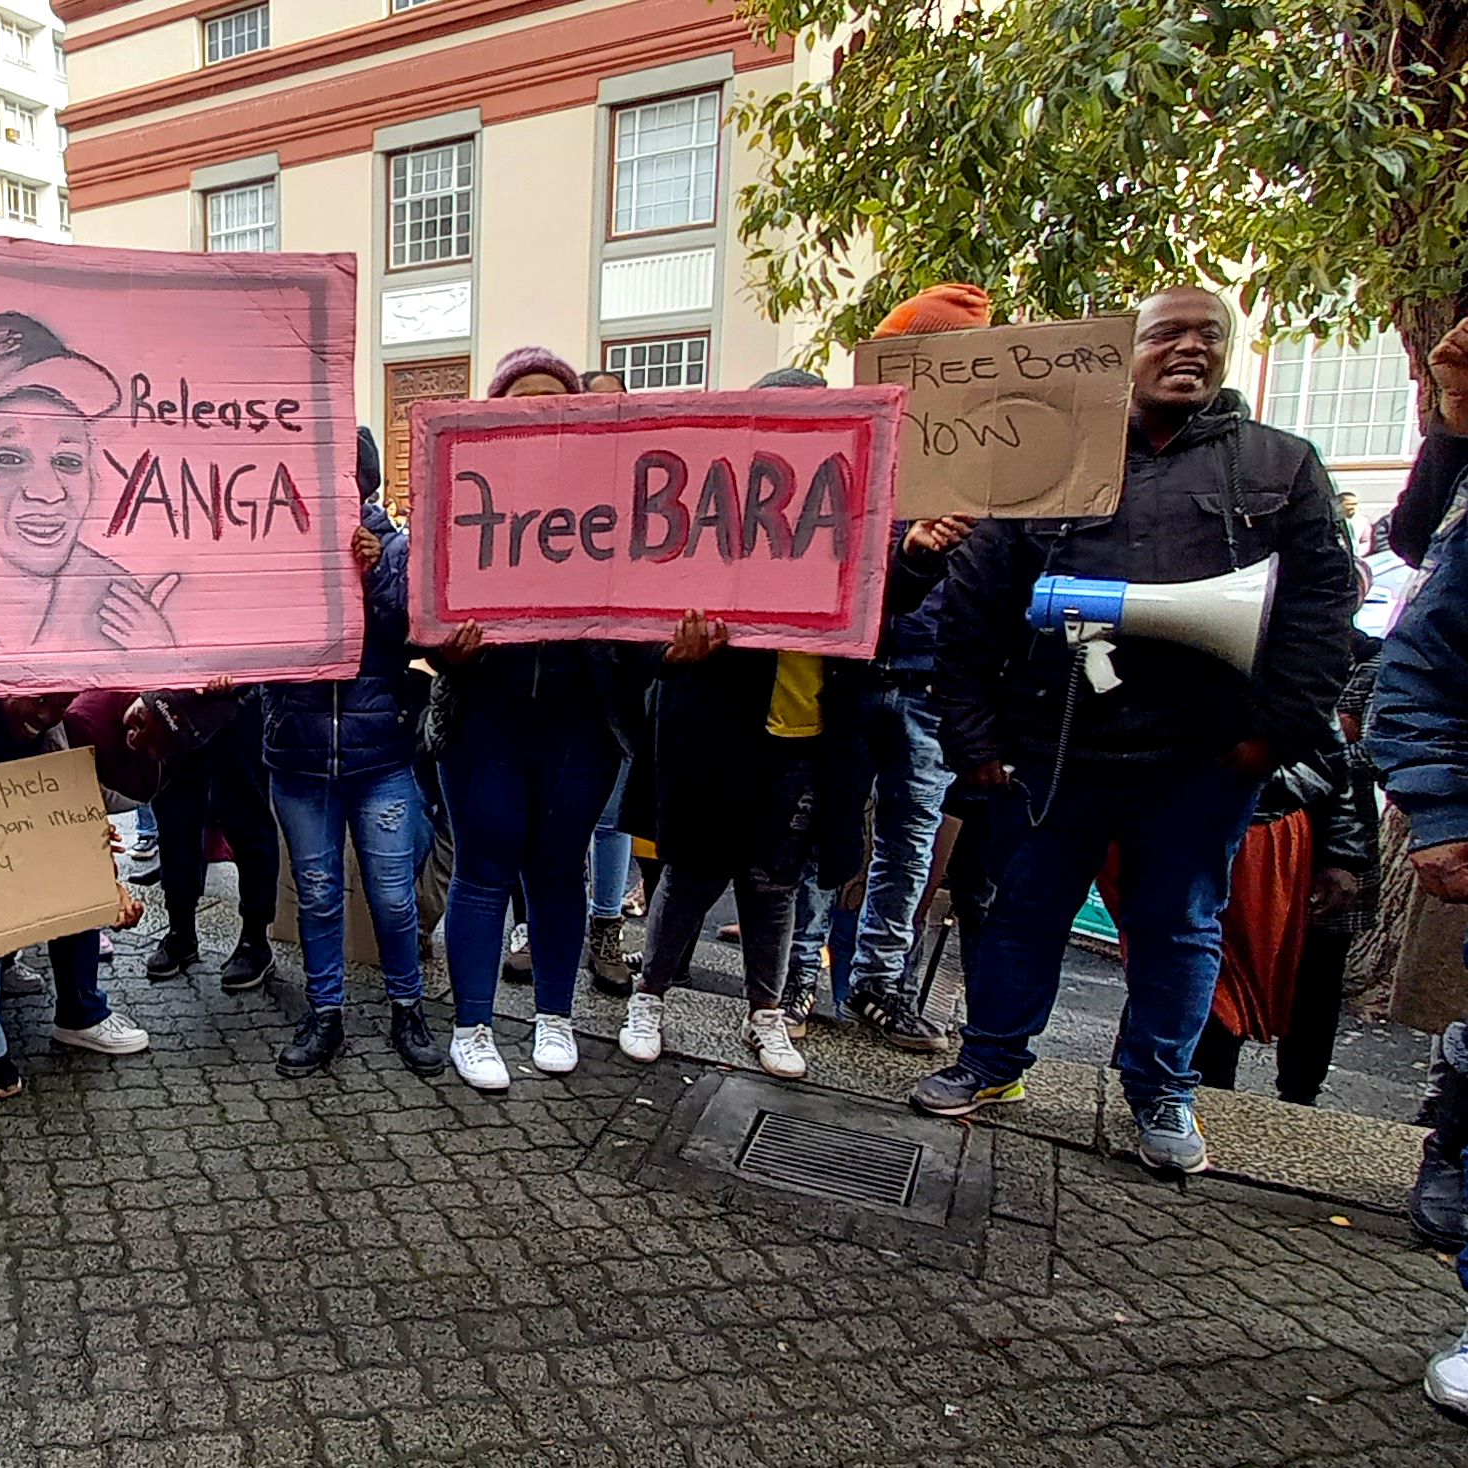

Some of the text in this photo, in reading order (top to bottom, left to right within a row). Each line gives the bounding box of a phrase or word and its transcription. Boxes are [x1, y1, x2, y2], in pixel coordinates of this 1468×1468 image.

[131, 373, 303, 433] Release
[877, 350, 999, 390] FREE
[102, 448, 310, 542] YANGA
[629, 449, 856, 566] BARA
